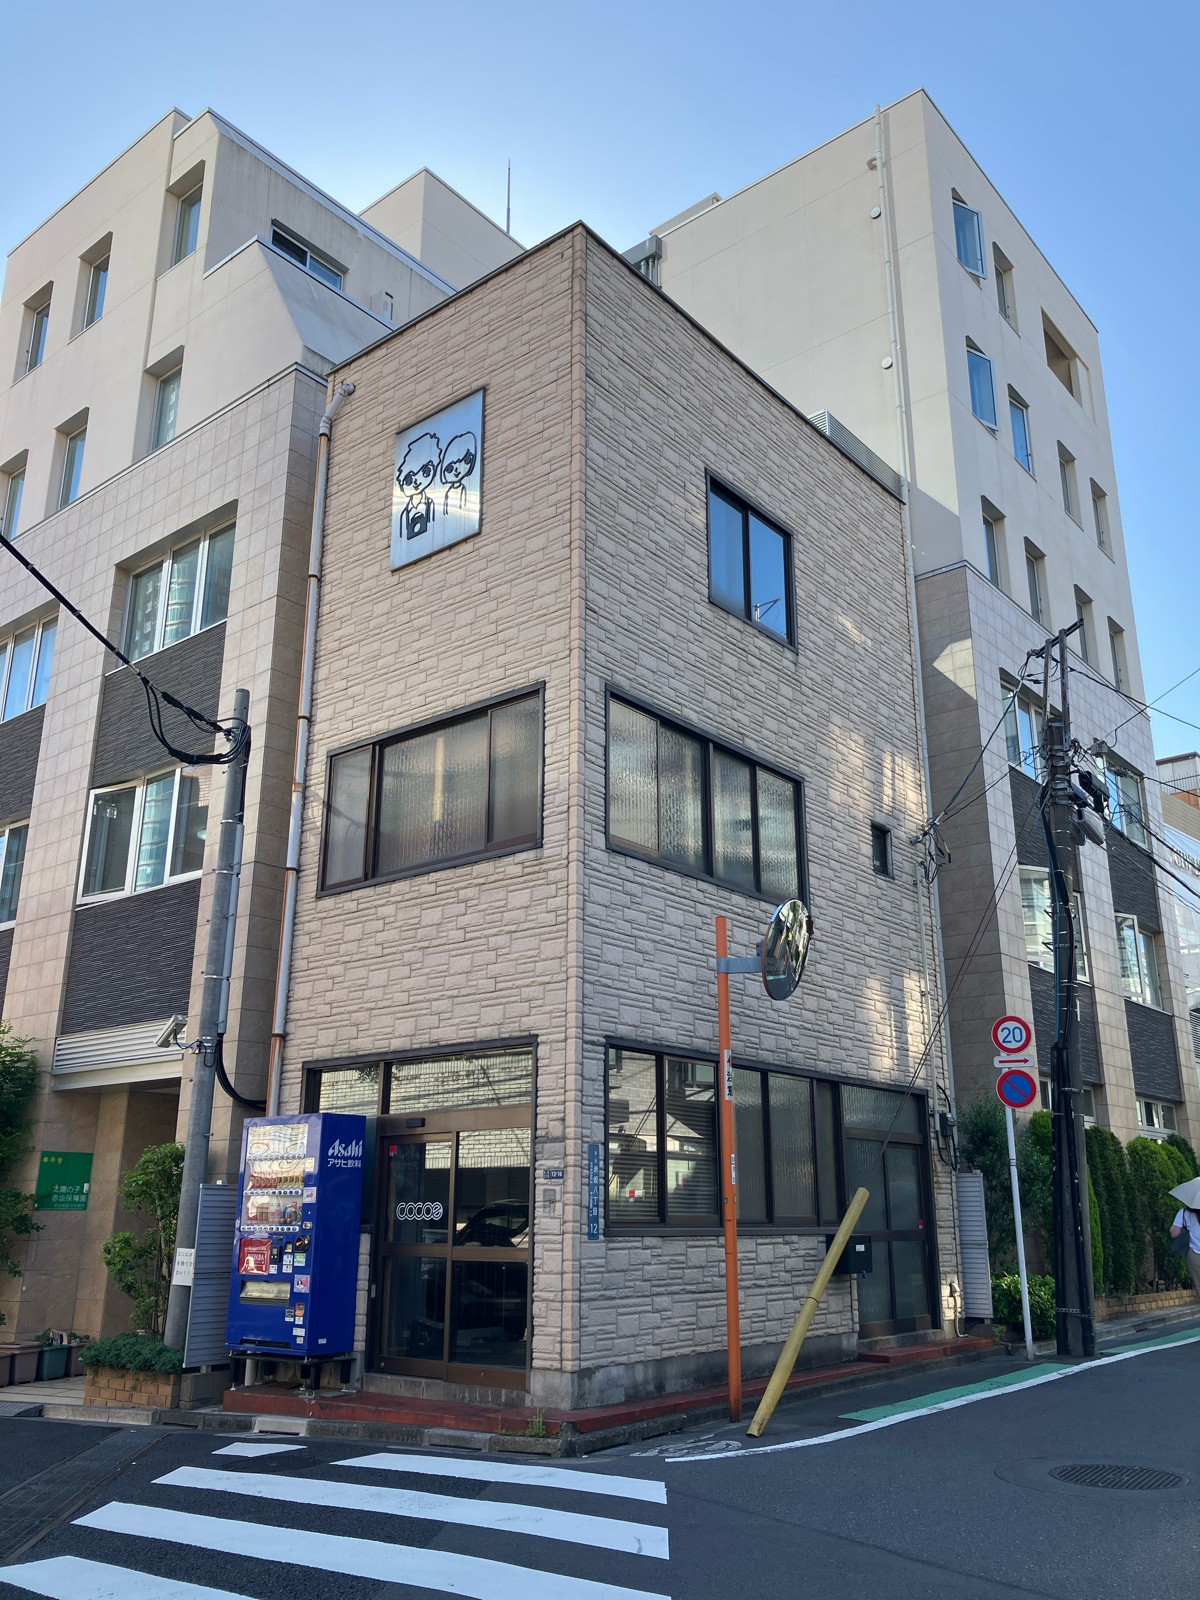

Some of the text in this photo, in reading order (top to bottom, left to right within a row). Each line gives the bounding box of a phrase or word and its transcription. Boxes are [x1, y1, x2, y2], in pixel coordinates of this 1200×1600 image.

[1001, 1026, 1023, 1043] 20
[327, 1138, 363, 1157] Asahi
[327, 1158, 362, 1168] アサヒ飲料
[53, 1185, 81, 1194] 太陽の子
[51, 1194, 87, 1203] 赤坂保育園
[590, 1223, 598, 1234] 12
